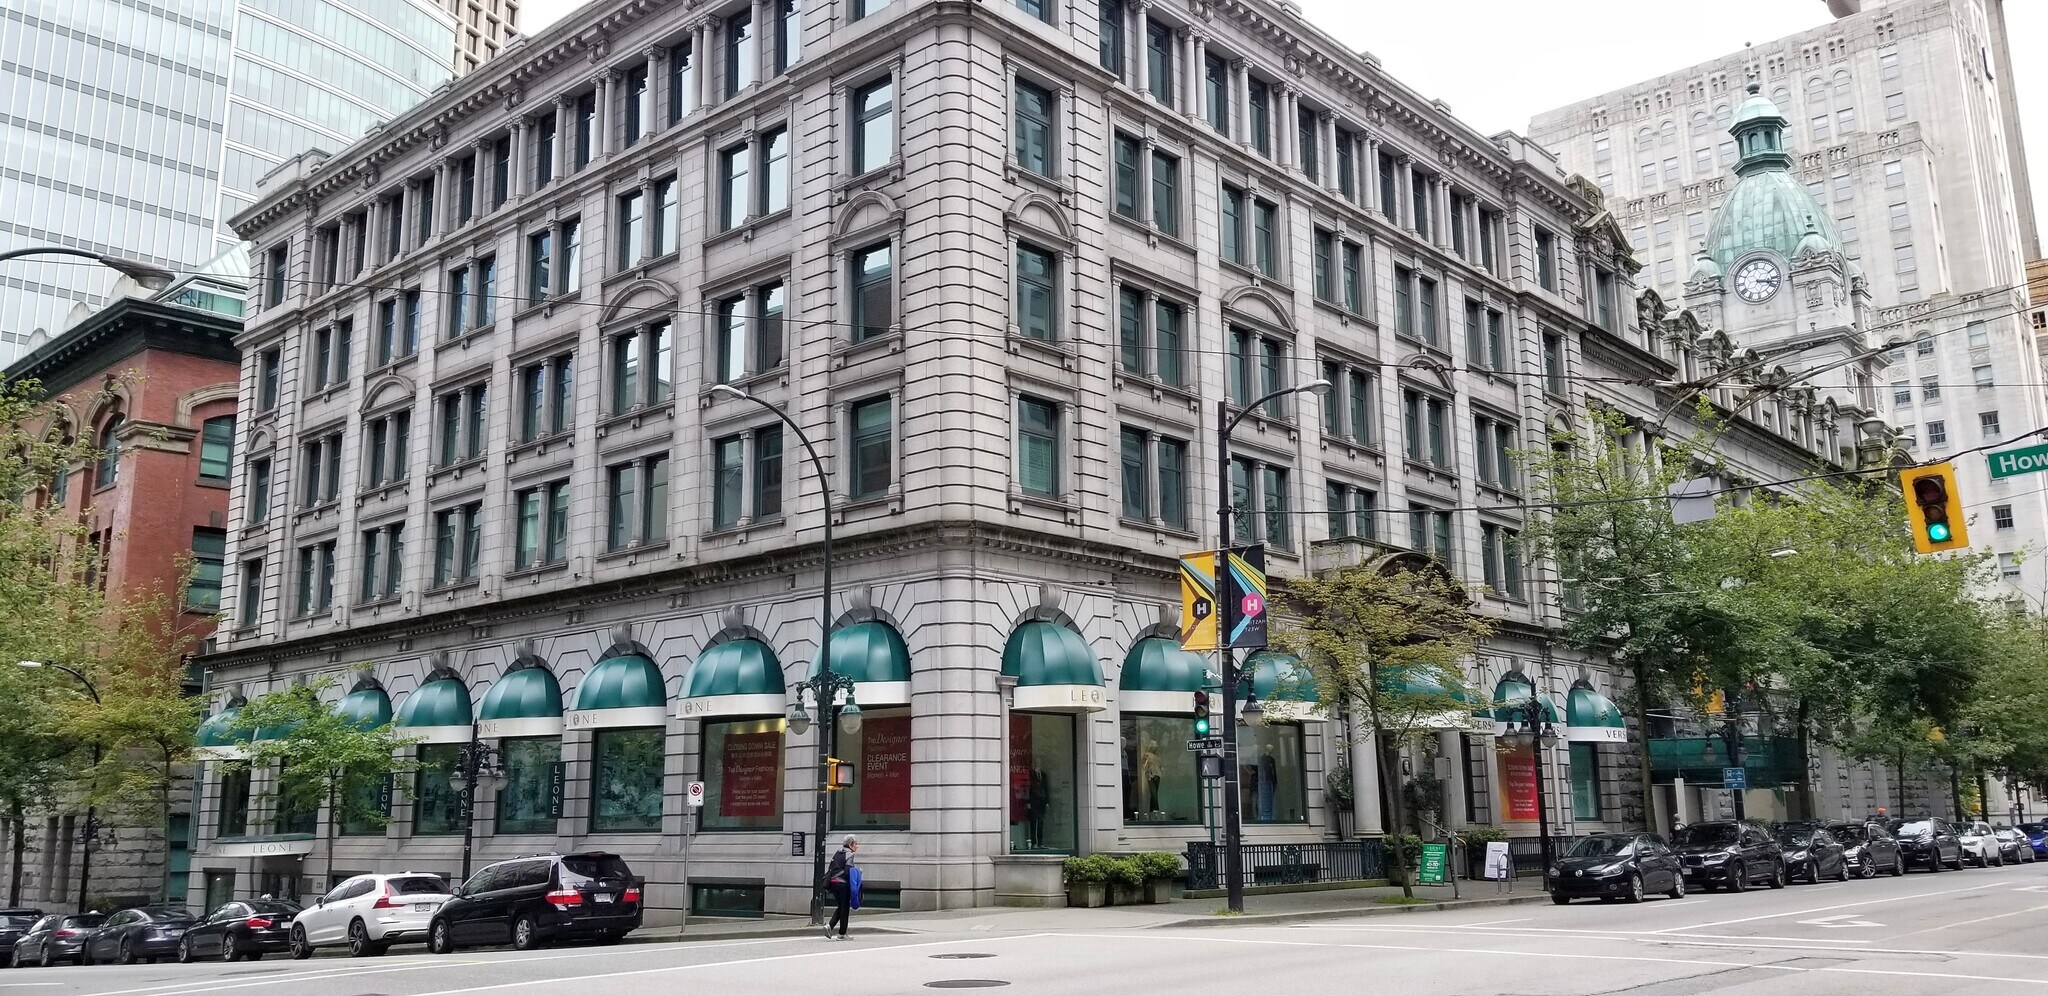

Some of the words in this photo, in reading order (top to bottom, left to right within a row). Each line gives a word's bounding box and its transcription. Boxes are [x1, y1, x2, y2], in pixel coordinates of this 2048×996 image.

[1999, 452, 2048, 473] How
[1196, 602, 1207, 615] H
[1247, 598, 1258, 612] H
[1188, 742, 1205, 750] Howe
[867, 752, 907, 762] CLEARANCE
[867, 762, 888, 771] EVENT
[552, 765, 560, 815] LEONE
[252, 843, 295, 854] LEONE
